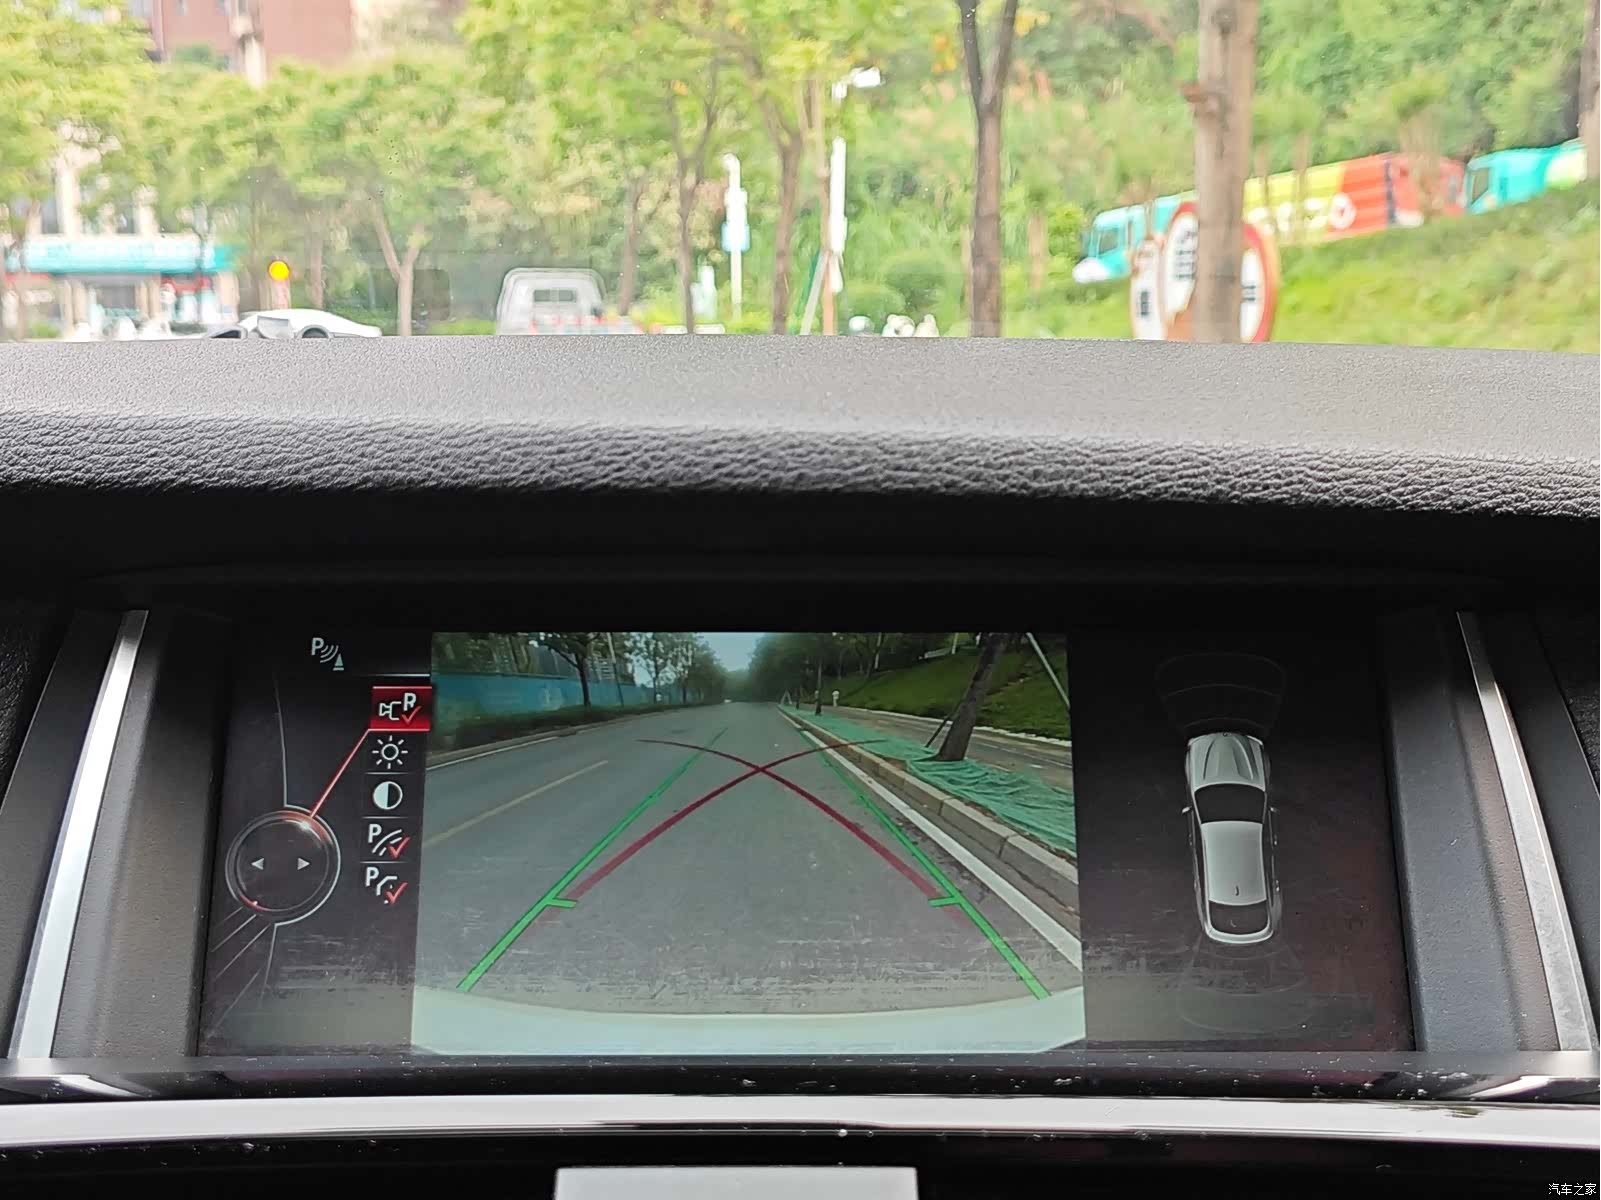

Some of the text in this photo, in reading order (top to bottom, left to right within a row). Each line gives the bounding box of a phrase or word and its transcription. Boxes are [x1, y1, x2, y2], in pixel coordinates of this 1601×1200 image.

[311, 637, 324, 656] P
[403, 692, 417, 711] R
[367, 823, 382, 843] P
[365, 866, 379, 887] P
